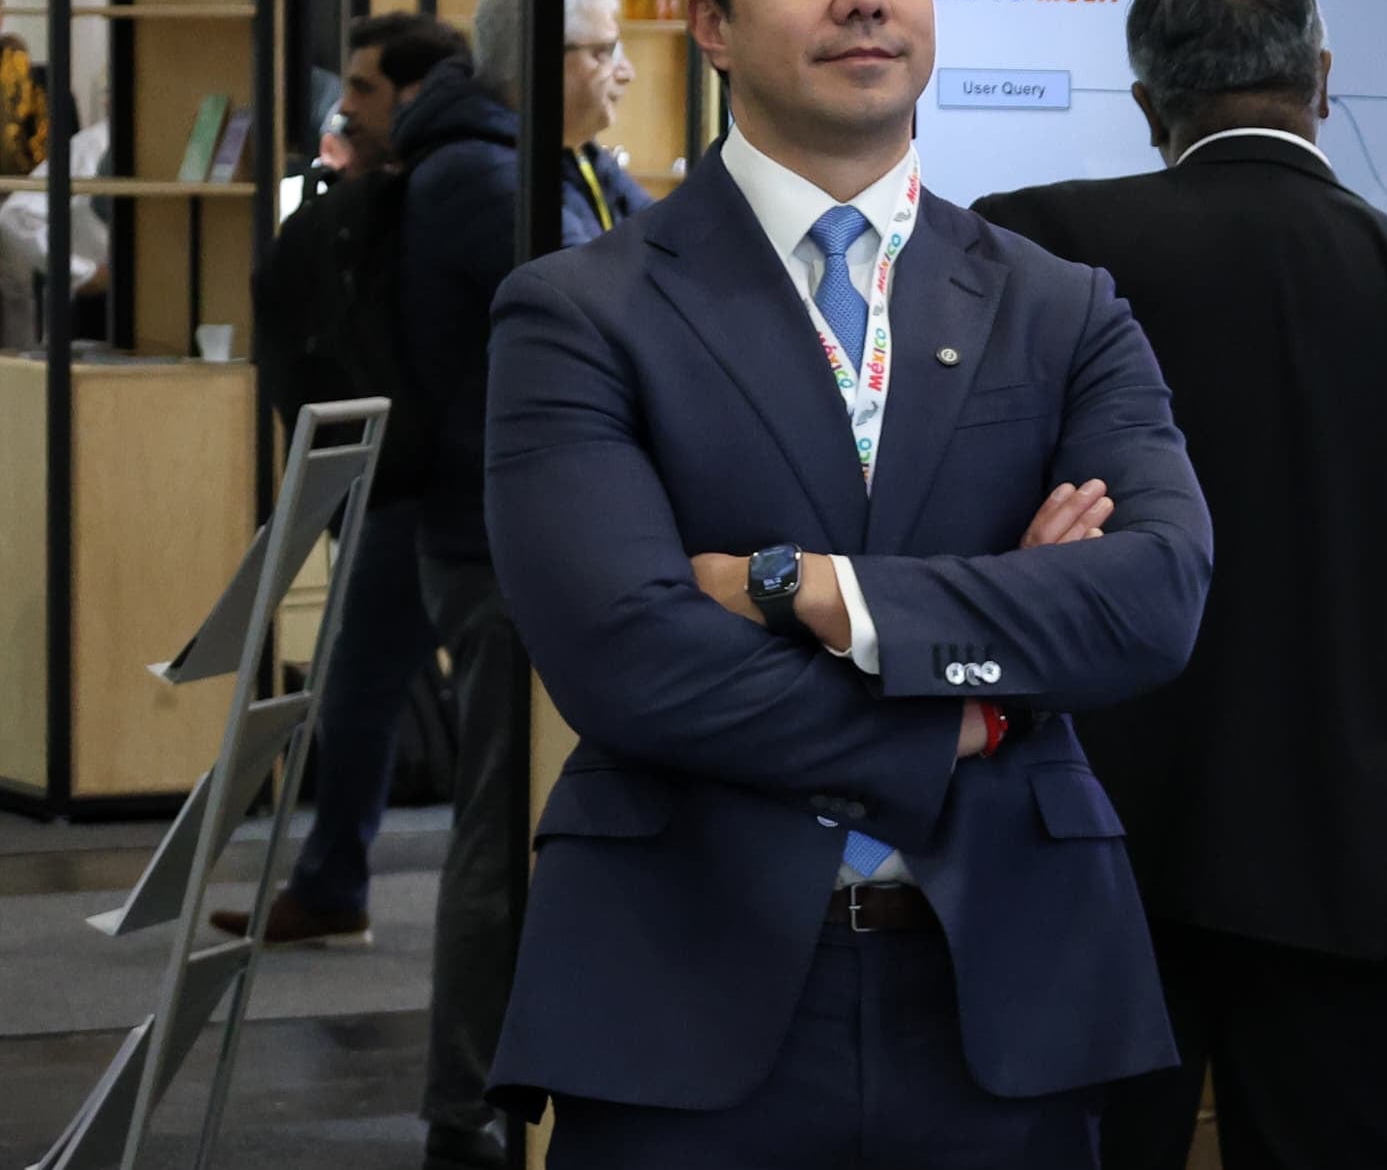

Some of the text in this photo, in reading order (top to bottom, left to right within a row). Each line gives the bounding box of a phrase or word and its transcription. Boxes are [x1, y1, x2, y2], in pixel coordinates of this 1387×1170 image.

[963, 81, 1046, 99] User Query
[868, 327, 888, 392] México
